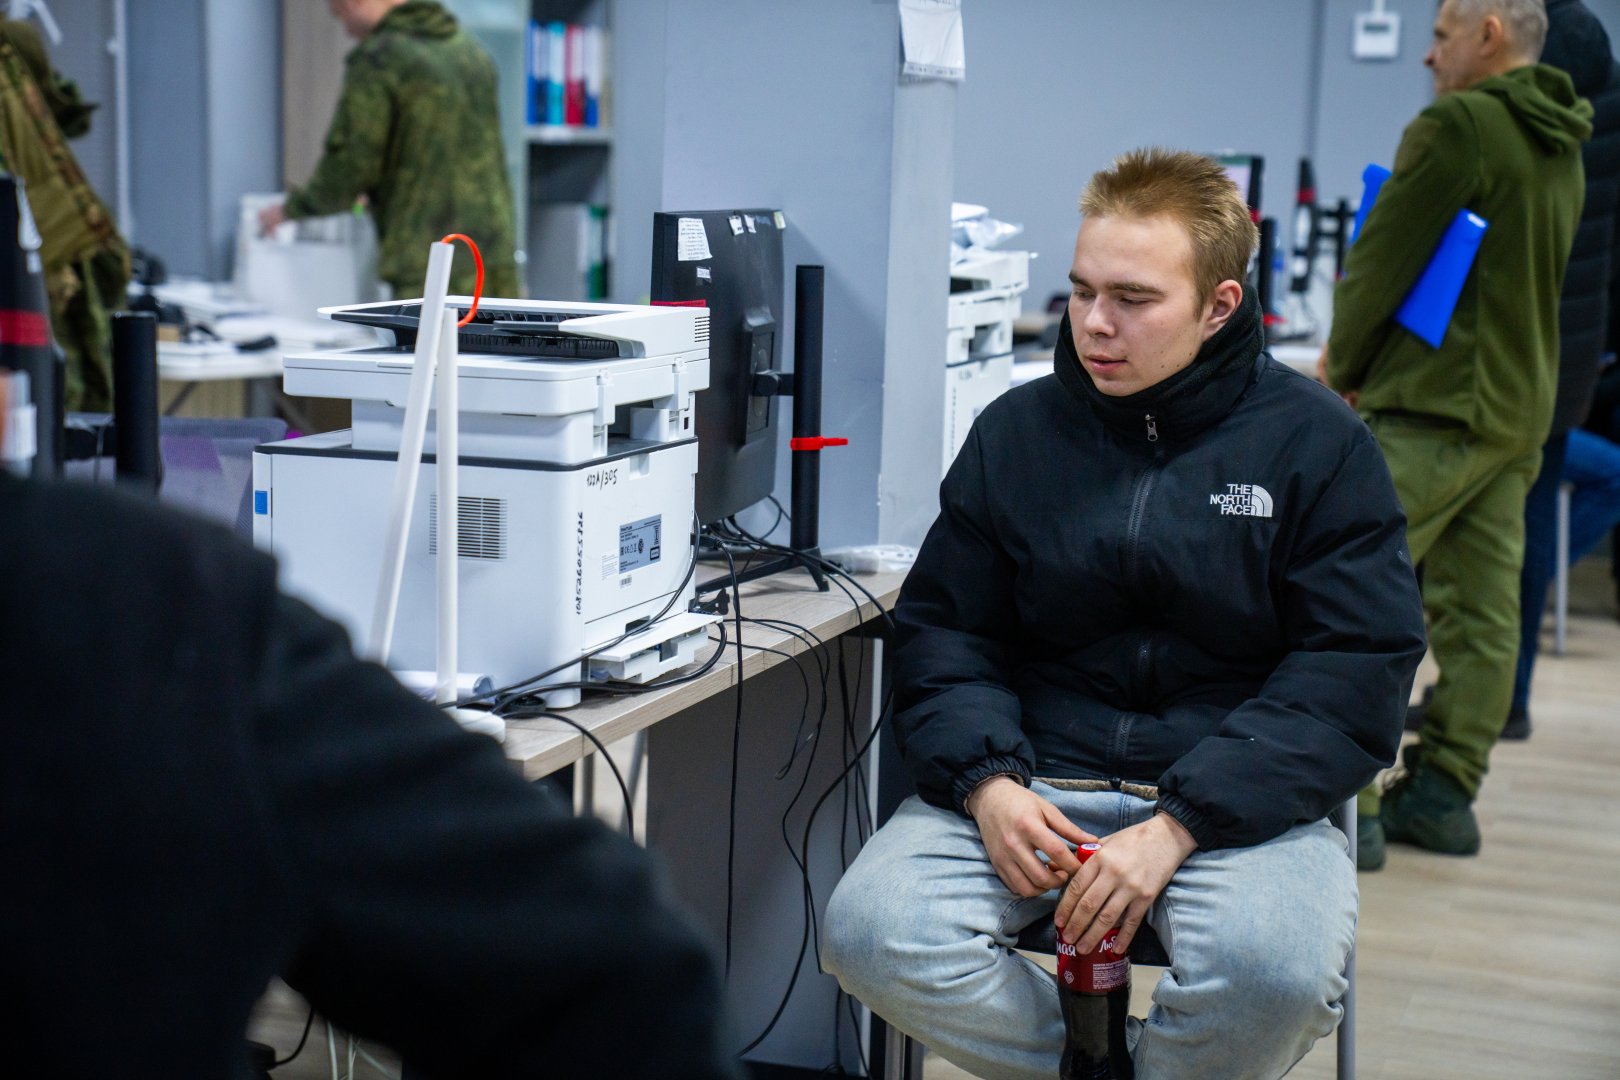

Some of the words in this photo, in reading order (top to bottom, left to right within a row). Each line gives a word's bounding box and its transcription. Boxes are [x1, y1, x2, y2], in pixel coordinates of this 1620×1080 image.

[1226, 483, 1252, 495] THE
[1209, 494, 1251, 506] NORTH
[1220, 504, 1252, 516] FACE
